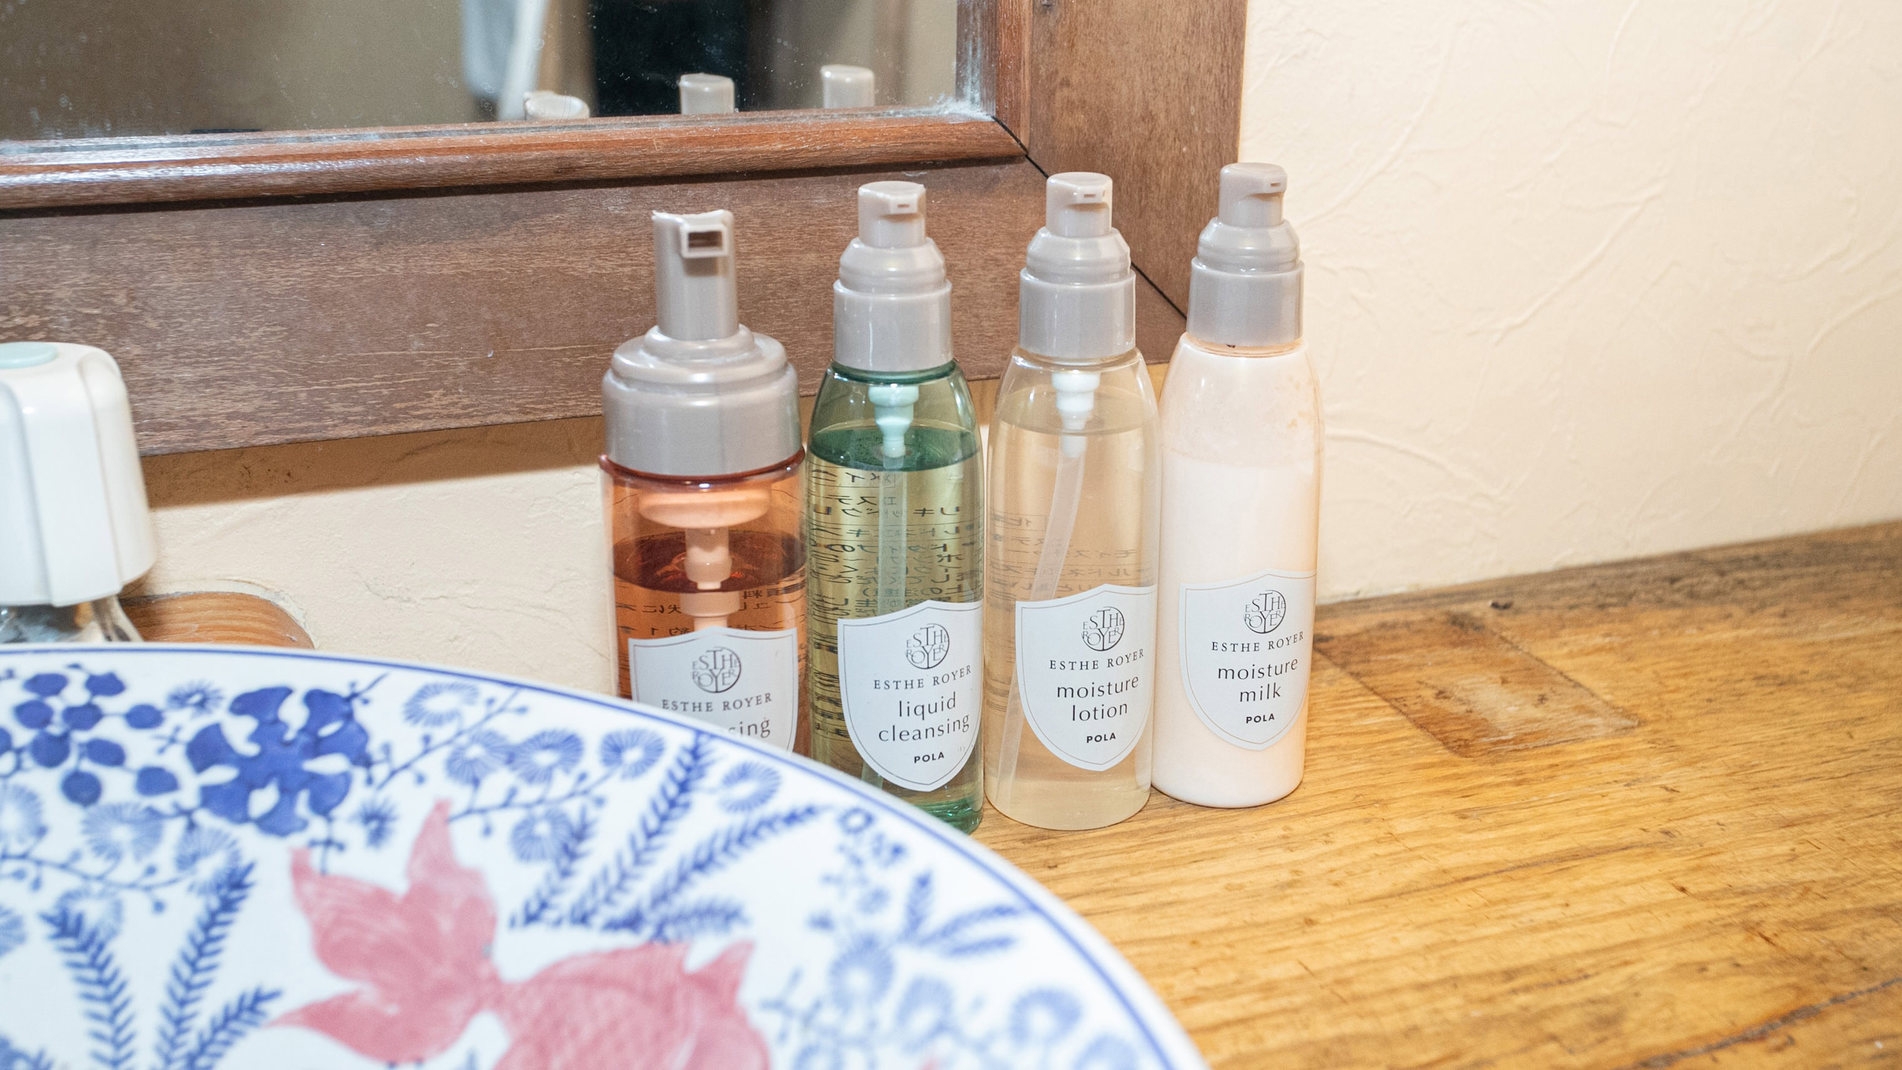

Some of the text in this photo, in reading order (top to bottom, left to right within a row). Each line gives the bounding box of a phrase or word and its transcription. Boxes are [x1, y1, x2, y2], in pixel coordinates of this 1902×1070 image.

[1211, 630, 1304, 653] ESTHE ROYER
[1049, 648, 1144, 671] ESTHE ROYER
[1218, 658, 1298, 680] moisture
[873, 664, 972, 690] ESTHE ROYER
[1056, 675, 1139, 699] moisture
[661, 692, 772, 713] ESTHE ROYER
[1239, 682, 1281, 702] milk
[898, 690, 956, 721] liquid
[1072, 702, 1128, 721] lotion
[878, 714, 970, 742] cleansing
[1245, 713, 1275, 724] POLA
[1086, 732, 1117, 743] POLA
[913, 751, 945, 764] POLA
